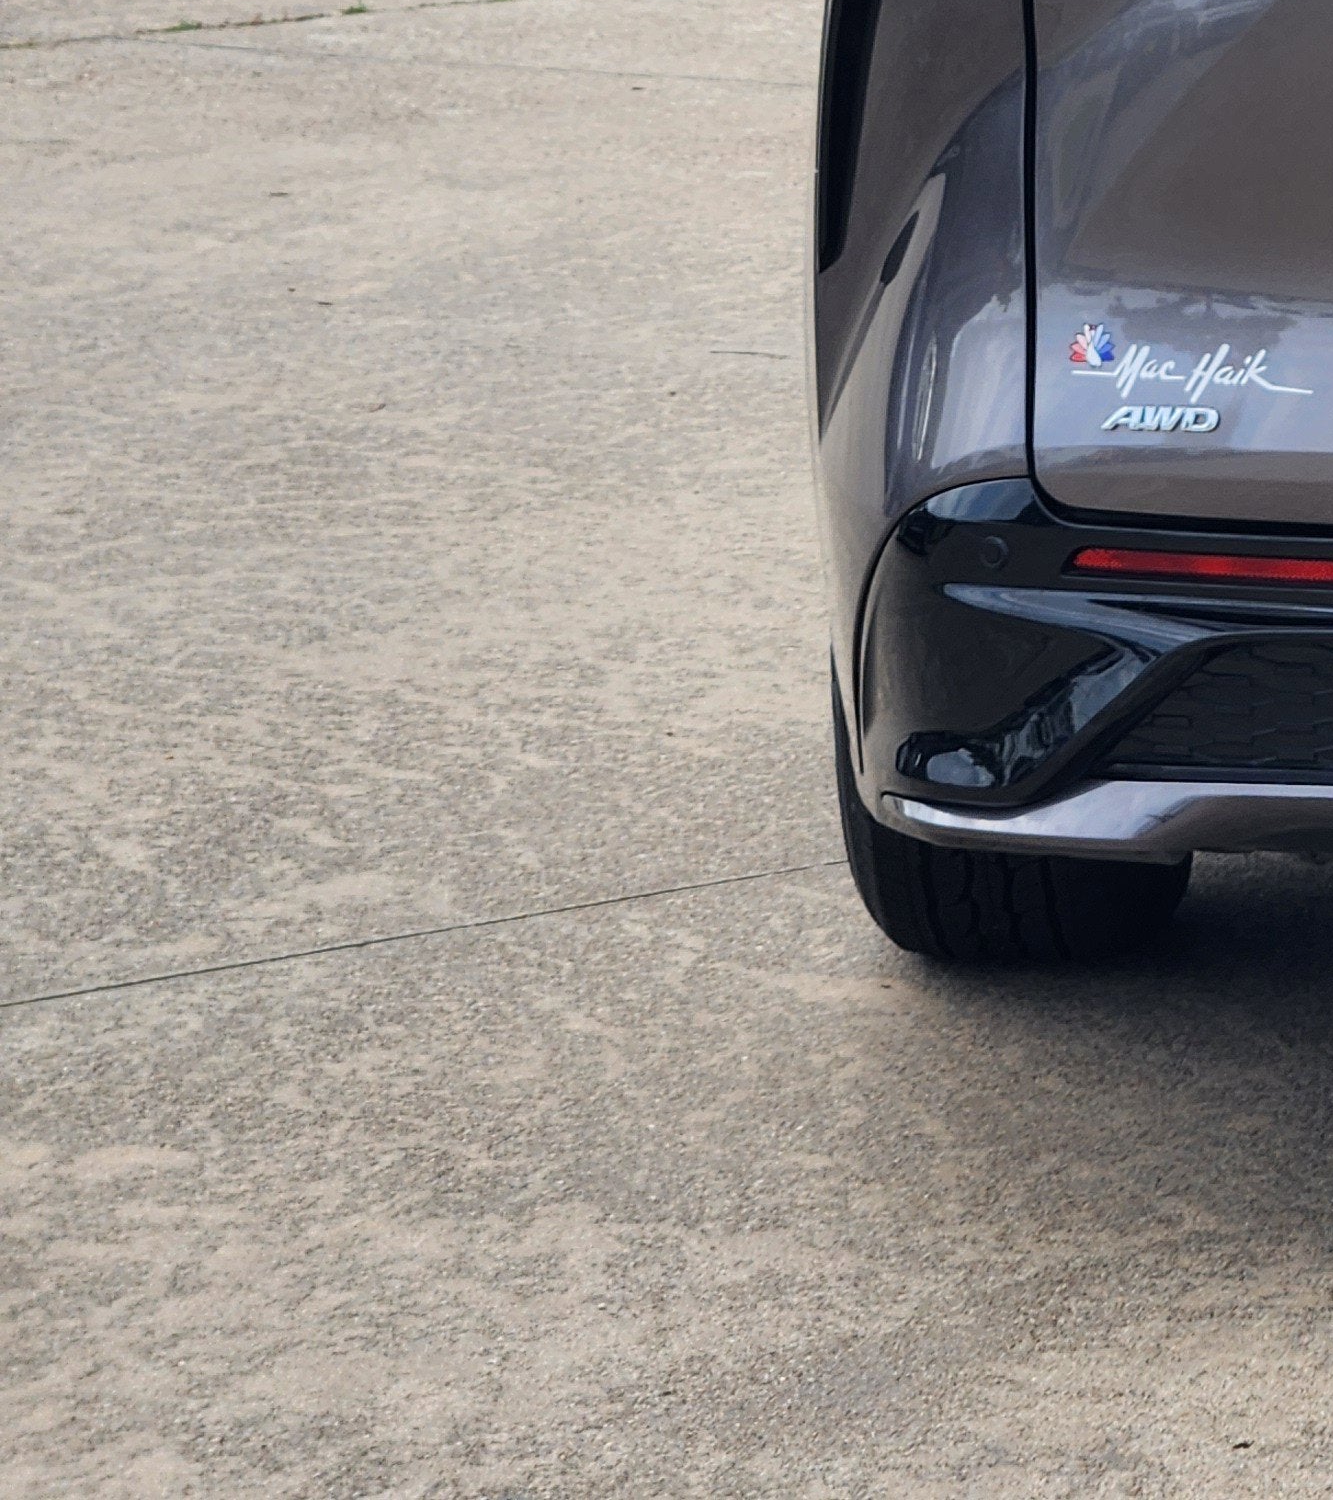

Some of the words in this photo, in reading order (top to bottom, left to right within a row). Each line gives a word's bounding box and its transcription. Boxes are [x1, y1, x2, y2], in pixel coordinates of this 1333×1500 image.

[1113, 343, 1185, 399] Mac
[1184, 343, 1272, 404] Haik
[1100, 404, 1222, 433] AWD
